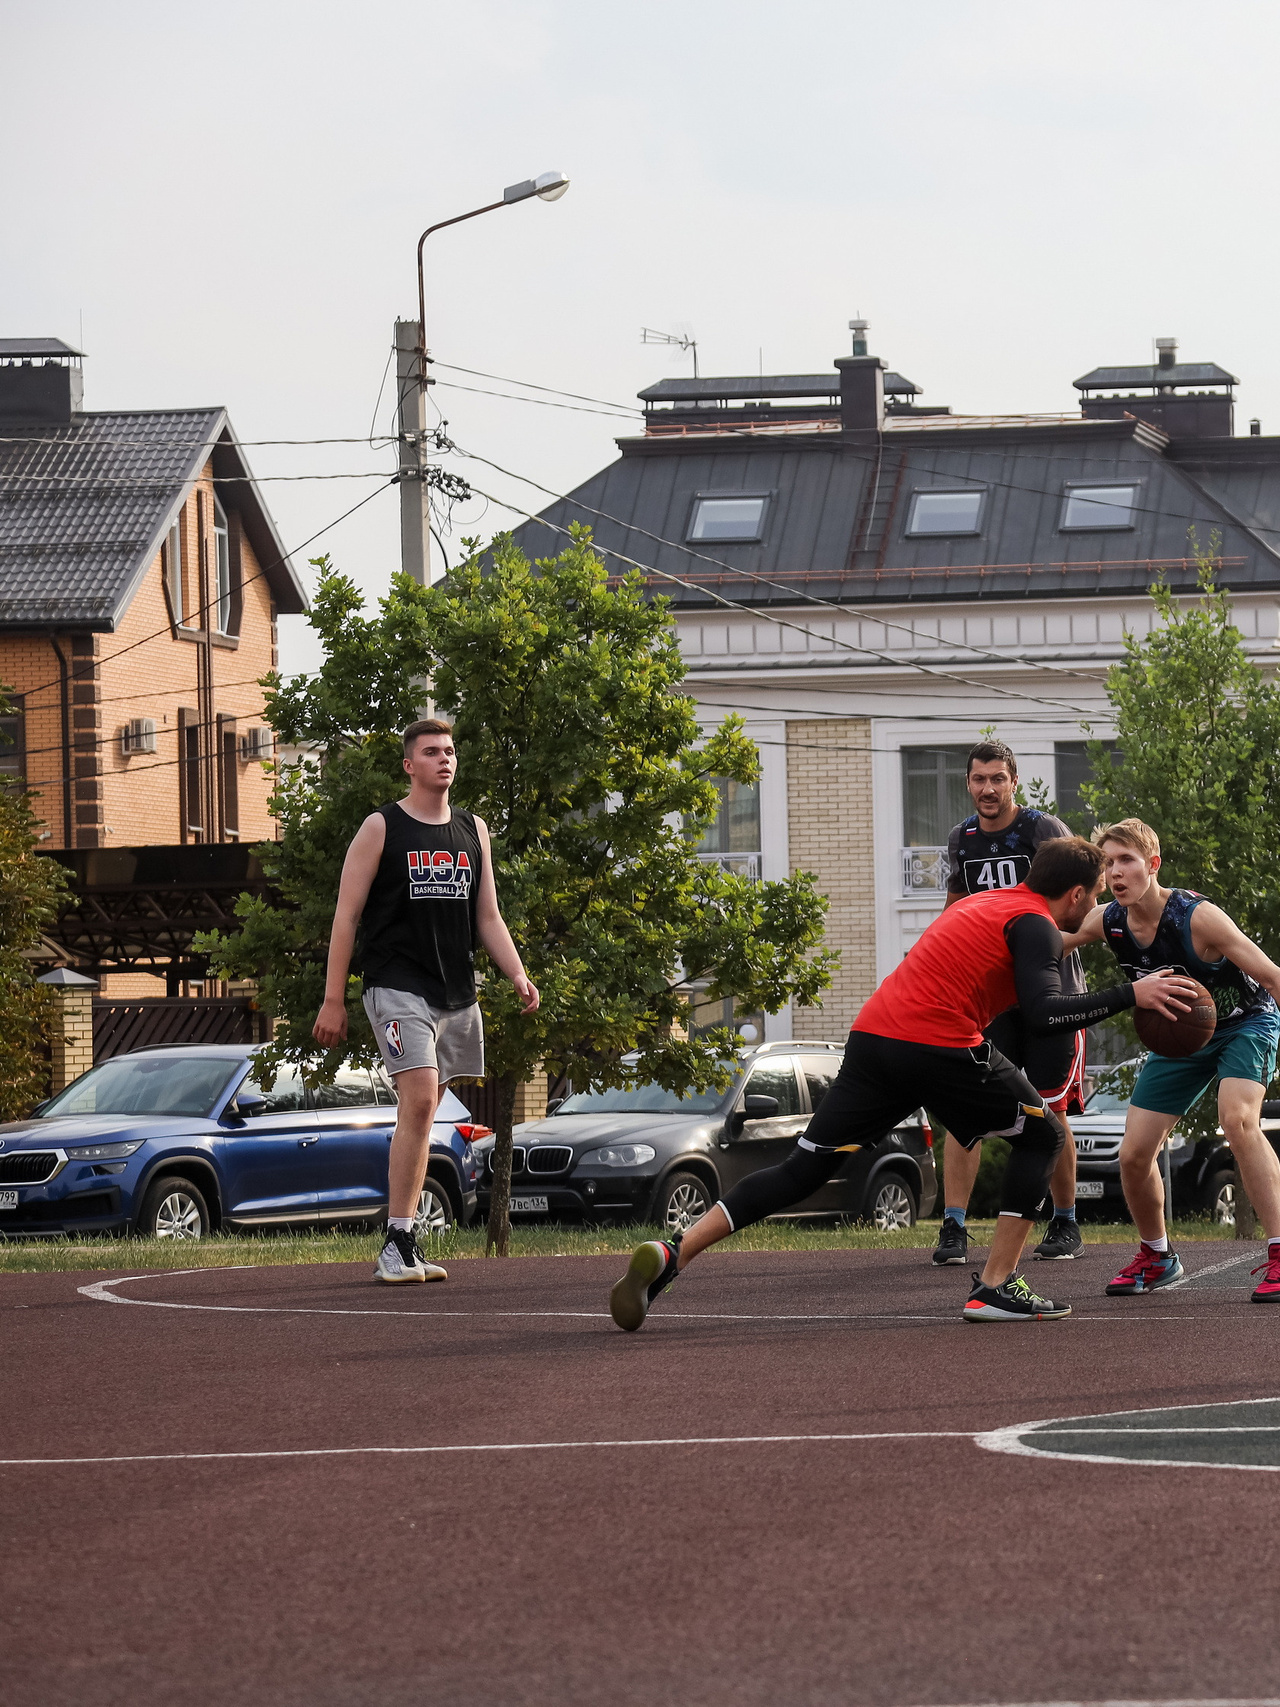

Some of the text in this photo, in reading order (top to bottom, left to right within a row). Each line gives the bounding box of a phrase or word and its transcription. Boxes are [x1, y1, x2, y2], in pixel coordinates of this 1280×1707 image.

[407, 850, 472, 883] USA
[976, 860, 1018, 890] 40
[414, 886, 456, 895] BASKETBALL
[1048, 1006, 1109, 1025] KEEP ROLLING
